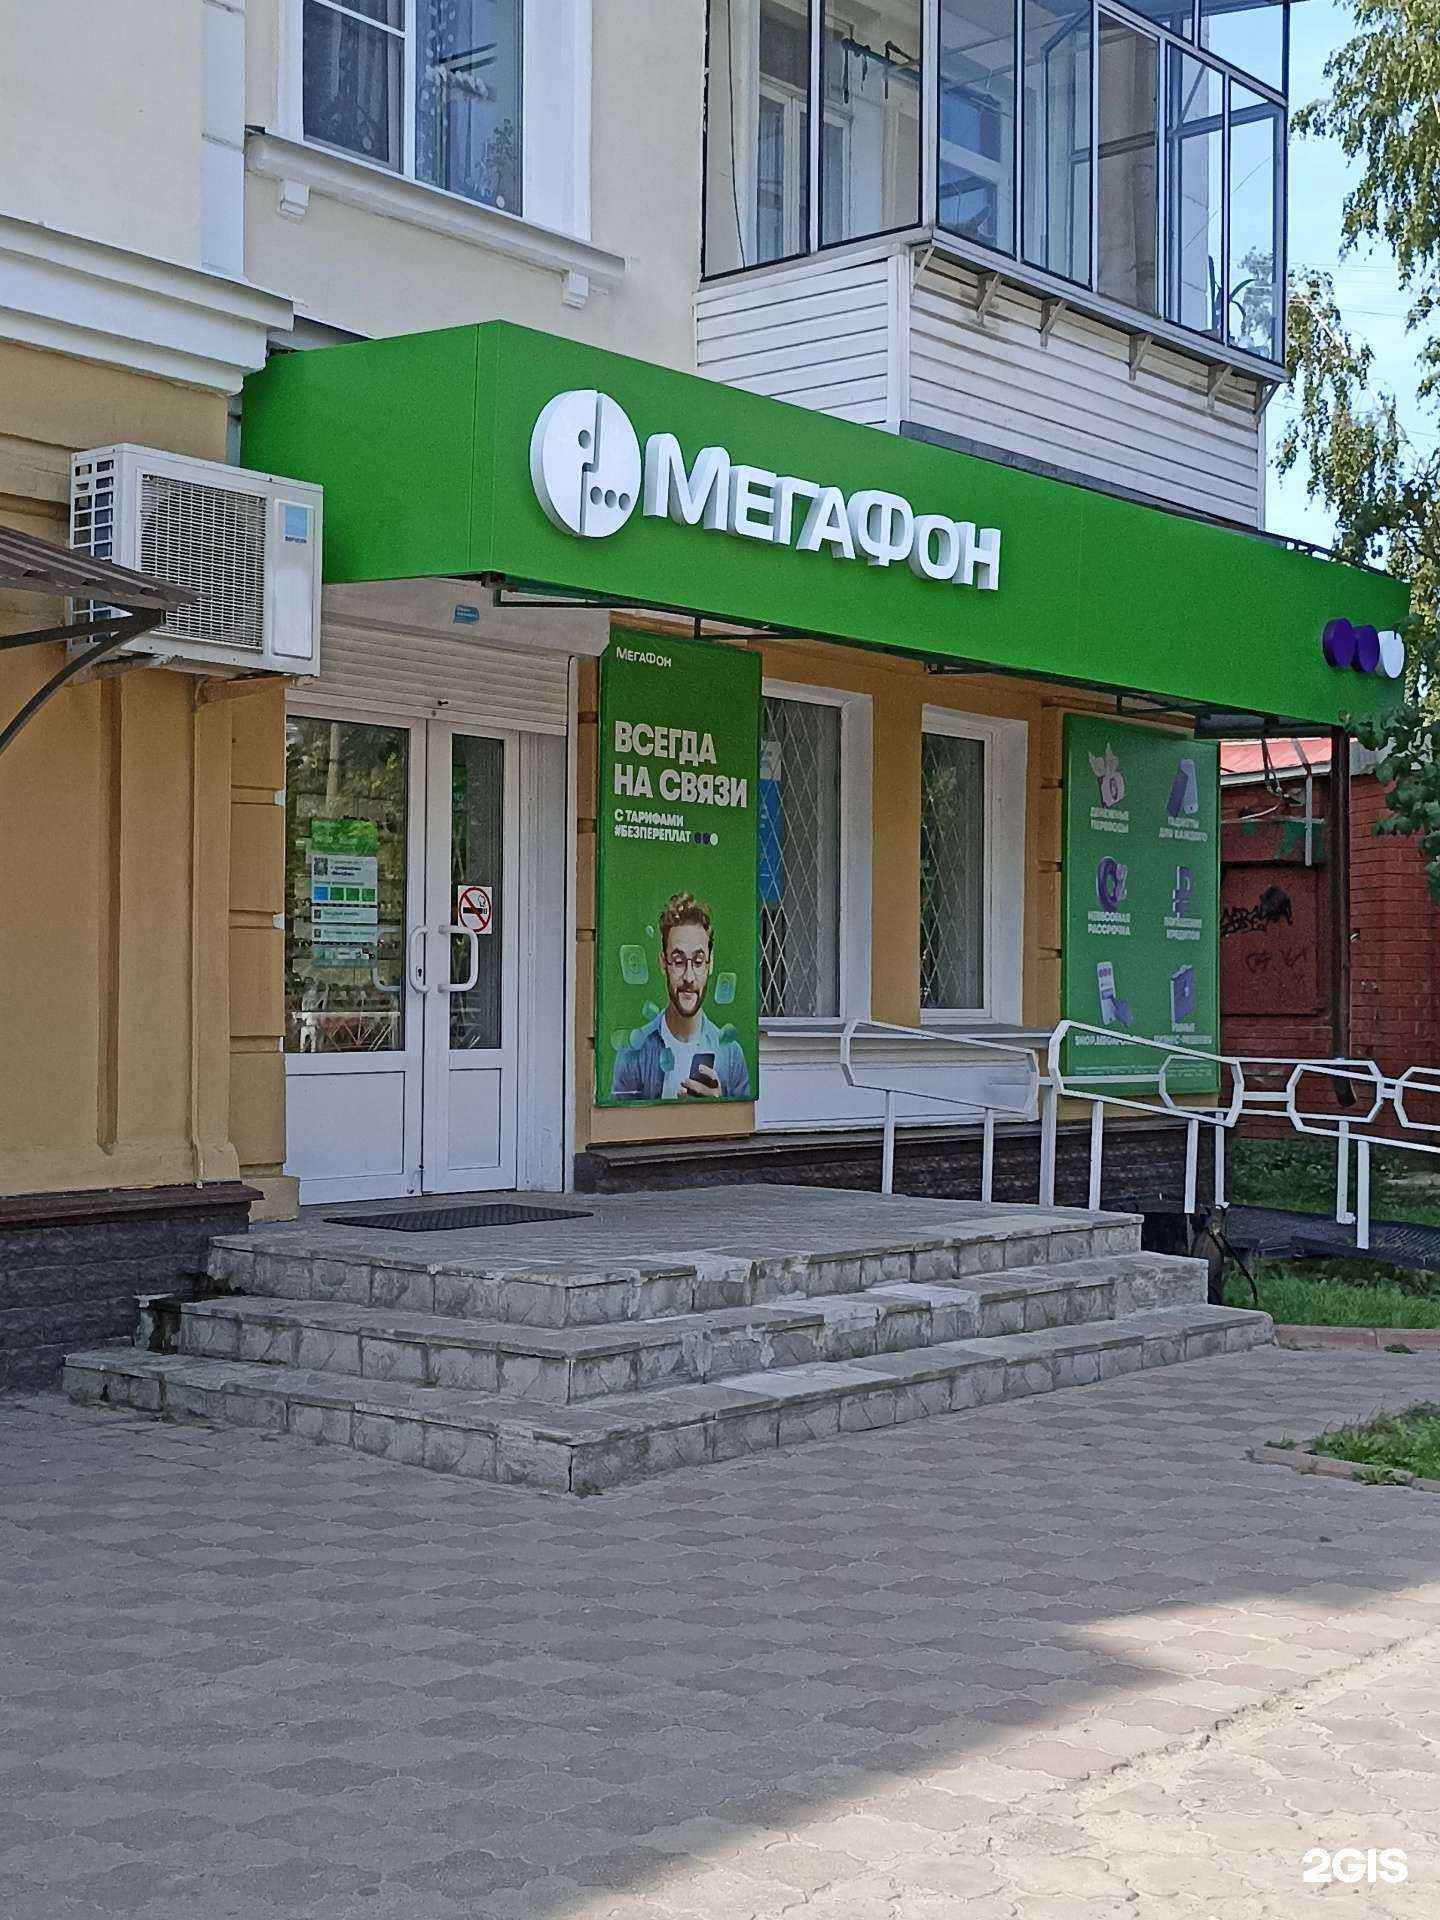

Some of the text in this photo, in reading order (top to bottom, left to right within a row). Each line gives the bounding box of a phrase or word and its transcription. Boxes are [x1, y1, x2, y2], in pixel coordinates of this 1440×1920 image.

[643, 433, 1001, 590] МЕГАФОН
[616, 646, 672, 667] МЕГАФОН
[614, 720, 717, 767] ВСЕГДА
[614, 763, 748, 808] НА СВЯЗИ
[614, 808, 684, 827] С ТАРИФАМИ
[614, 824, 692, 843] #БЕЗПЕРЕПЛАТ
